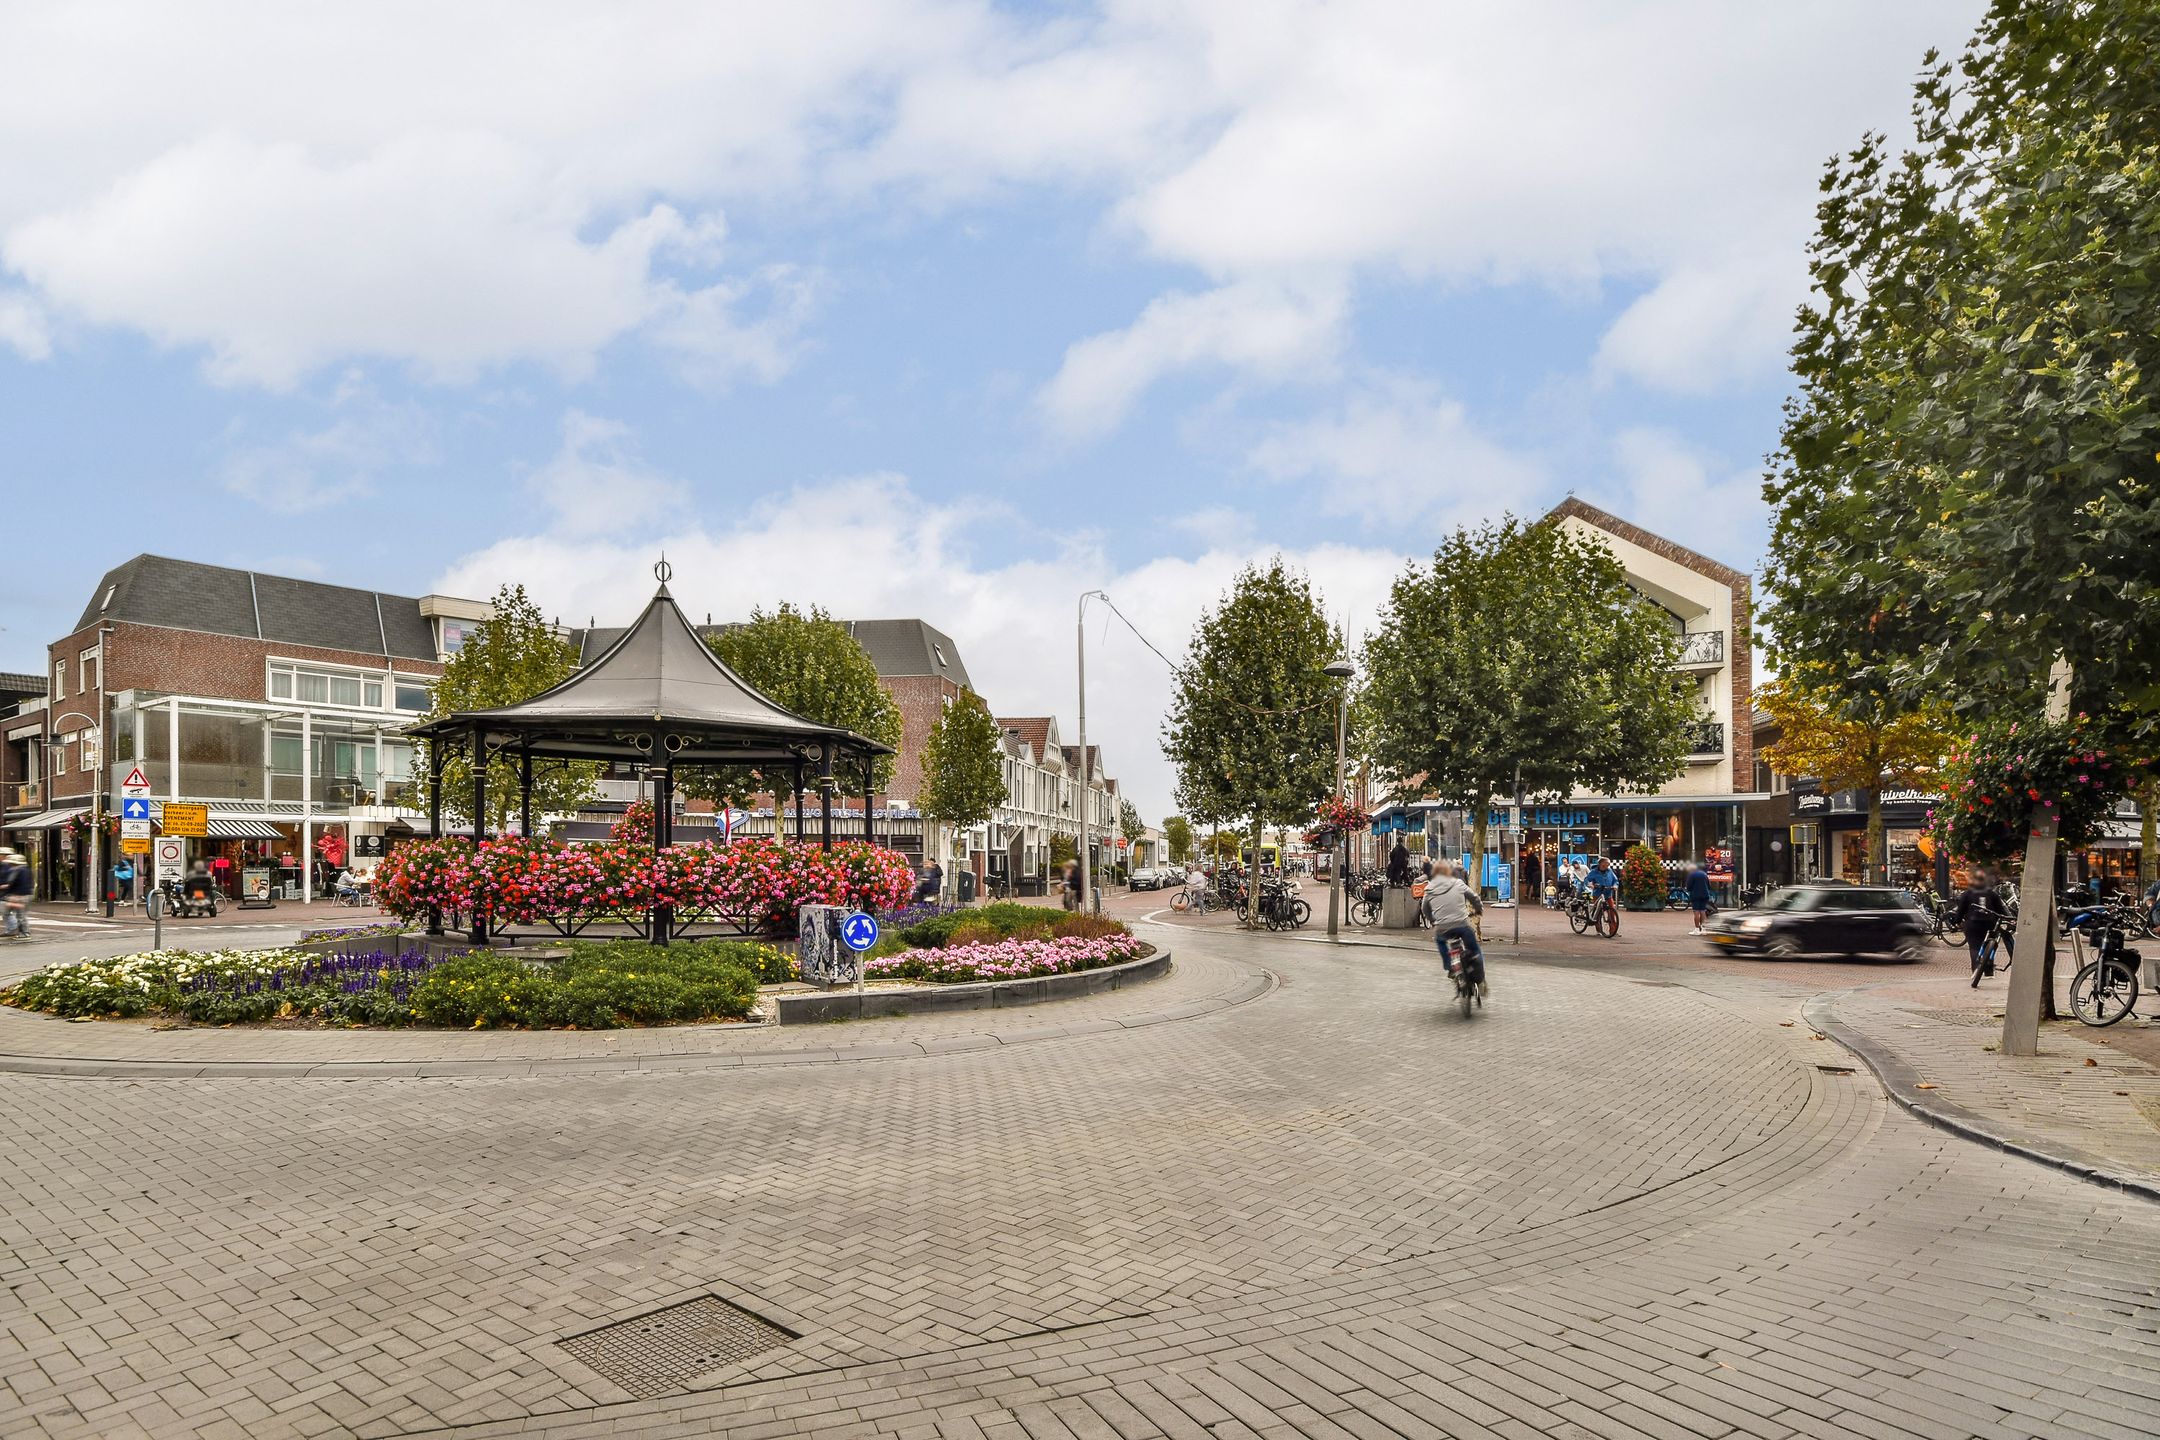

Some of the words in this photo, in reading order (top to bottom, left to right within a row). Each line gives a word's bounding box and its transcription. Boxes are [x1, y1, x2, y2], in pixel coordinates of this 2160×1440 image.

[757, 807, 774, 817] DE
[1535, 807, 1588, 827] Heijn
[1720, 850, 1731, 858] 20
